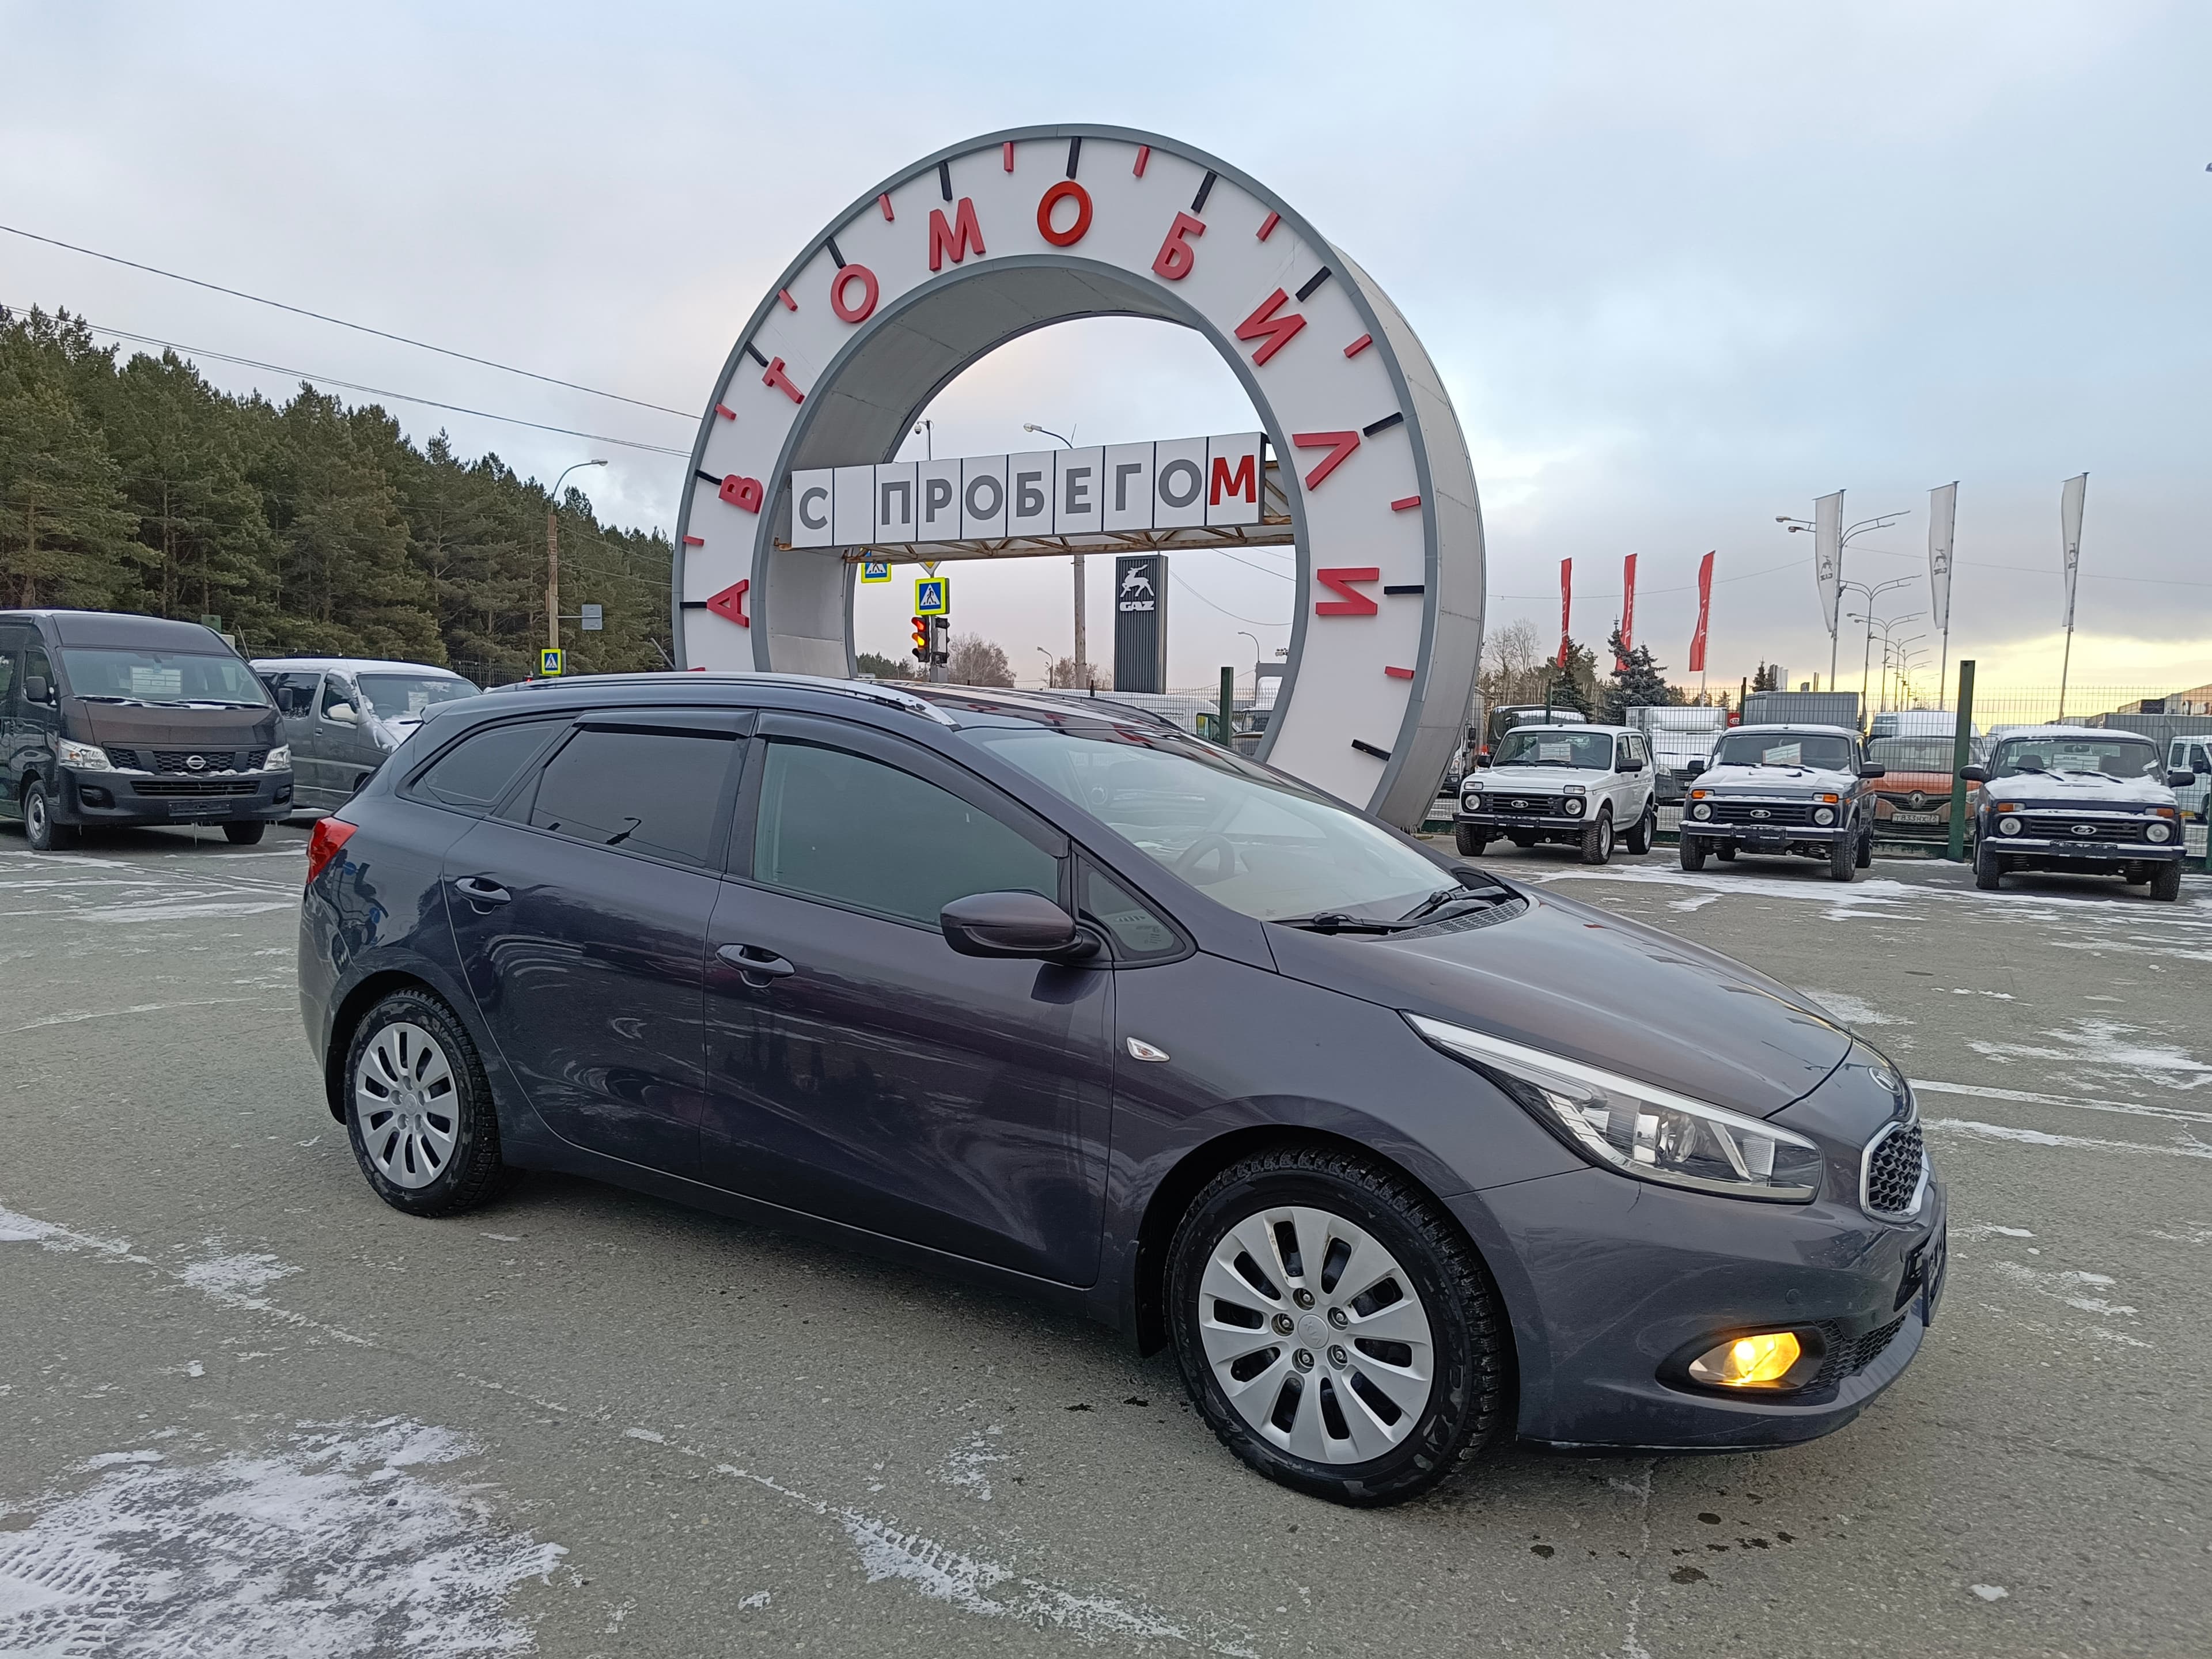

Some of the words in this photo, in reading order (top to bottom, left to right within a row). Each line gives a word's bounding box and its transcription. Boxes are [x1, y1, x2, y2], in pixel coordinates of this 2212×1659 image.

[706, 180, 1381, 628] АВТОМОБИЛИ
[798, 487, 828, 530] С
[881, 454, 1256, 525] ПРОБЕГОМ
[1119, 600, 1154, 611] GAZ
